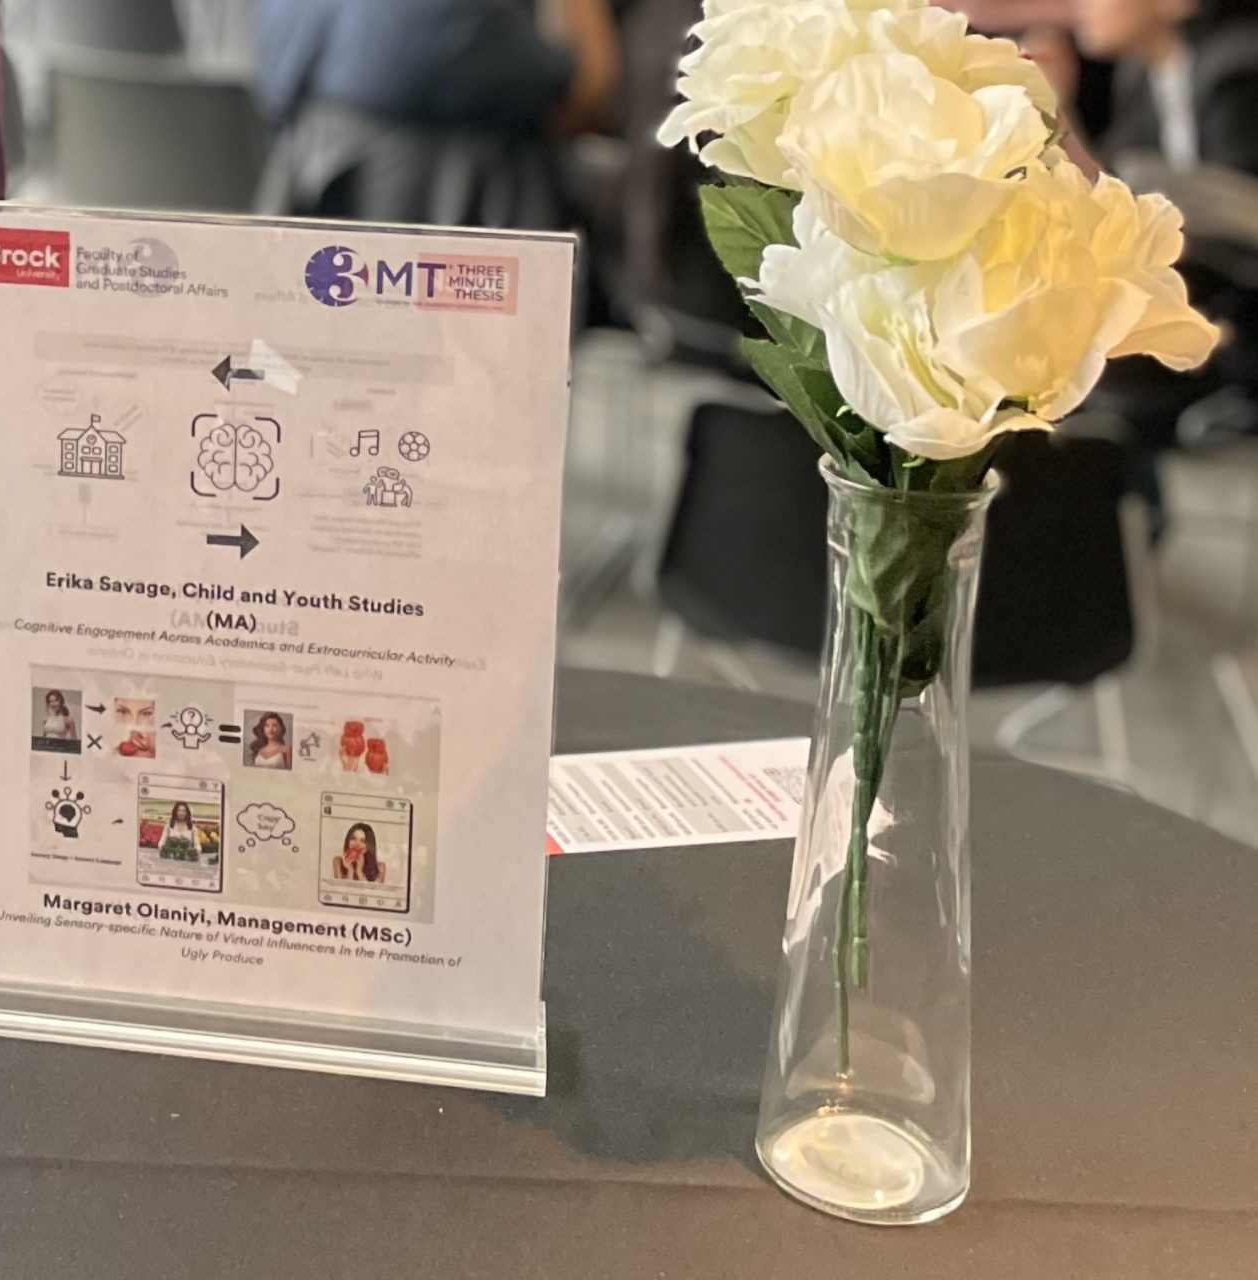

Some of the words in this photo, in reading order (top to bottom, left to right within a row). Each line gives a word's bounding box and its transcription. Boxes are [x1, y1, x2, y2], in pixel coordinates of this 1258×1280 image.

[76, 247, 123, 263] Faculty
[126, 249, 140, 261] of
[16, 268, 60, 281] University
[76, 264, 136, 277] Graduate
[139, 265, 187, 280] Studies
[458, 264, 505, 276] THREE
[76, 279, 99, 290] and
[103, 280, 184, 295] Postdoctoral
[187, 285, 229, 298] Affairs
[449, 277, 504, 289] MINUTE
[454, 288, 504, 301] THESIS
[45, 572, 93, 592] Erika
[99, 575, 176, 599] Savage,
[183, 581, 234, 603] Child
[240, 587, 277, 606] and
[282, 589, 342, 611] Youth
[349, 595, 424, 617] Studies
[206, 610, 257, 634] (MA)
[14, 618, 72, 634] Cognitive
[77, 623, 155, 641] Engagement
[158, 631, 201, 644] Across
[205, 633, 275, 652] Academics
[280, 641, 304, 654] and
[308, 642, 404, 662] Extracurricular
[406, 651, 456, 668] Activity
[43, 893, 132, 917] Margaret
[137, 903, 212, 927] Olaniyi,
[217, 910, 346, 940] Management
[352, 921, 413, 947] (MSc)
[55, 913, 156, 938] Sensory-specific
[159, 926, 203, 942] Nature
[207, 930, 220, 943] of
[223, 931, 263, 948] Virtual
[267, 935, 335, 955] Influencers
[355, 945, 375, 958] the
[379, 948, 444, 967] Promotion
[448, 955, 462, 968] of
[181, 947, 209, 963] Ugly
[213, 948, 264, 965] Produce
